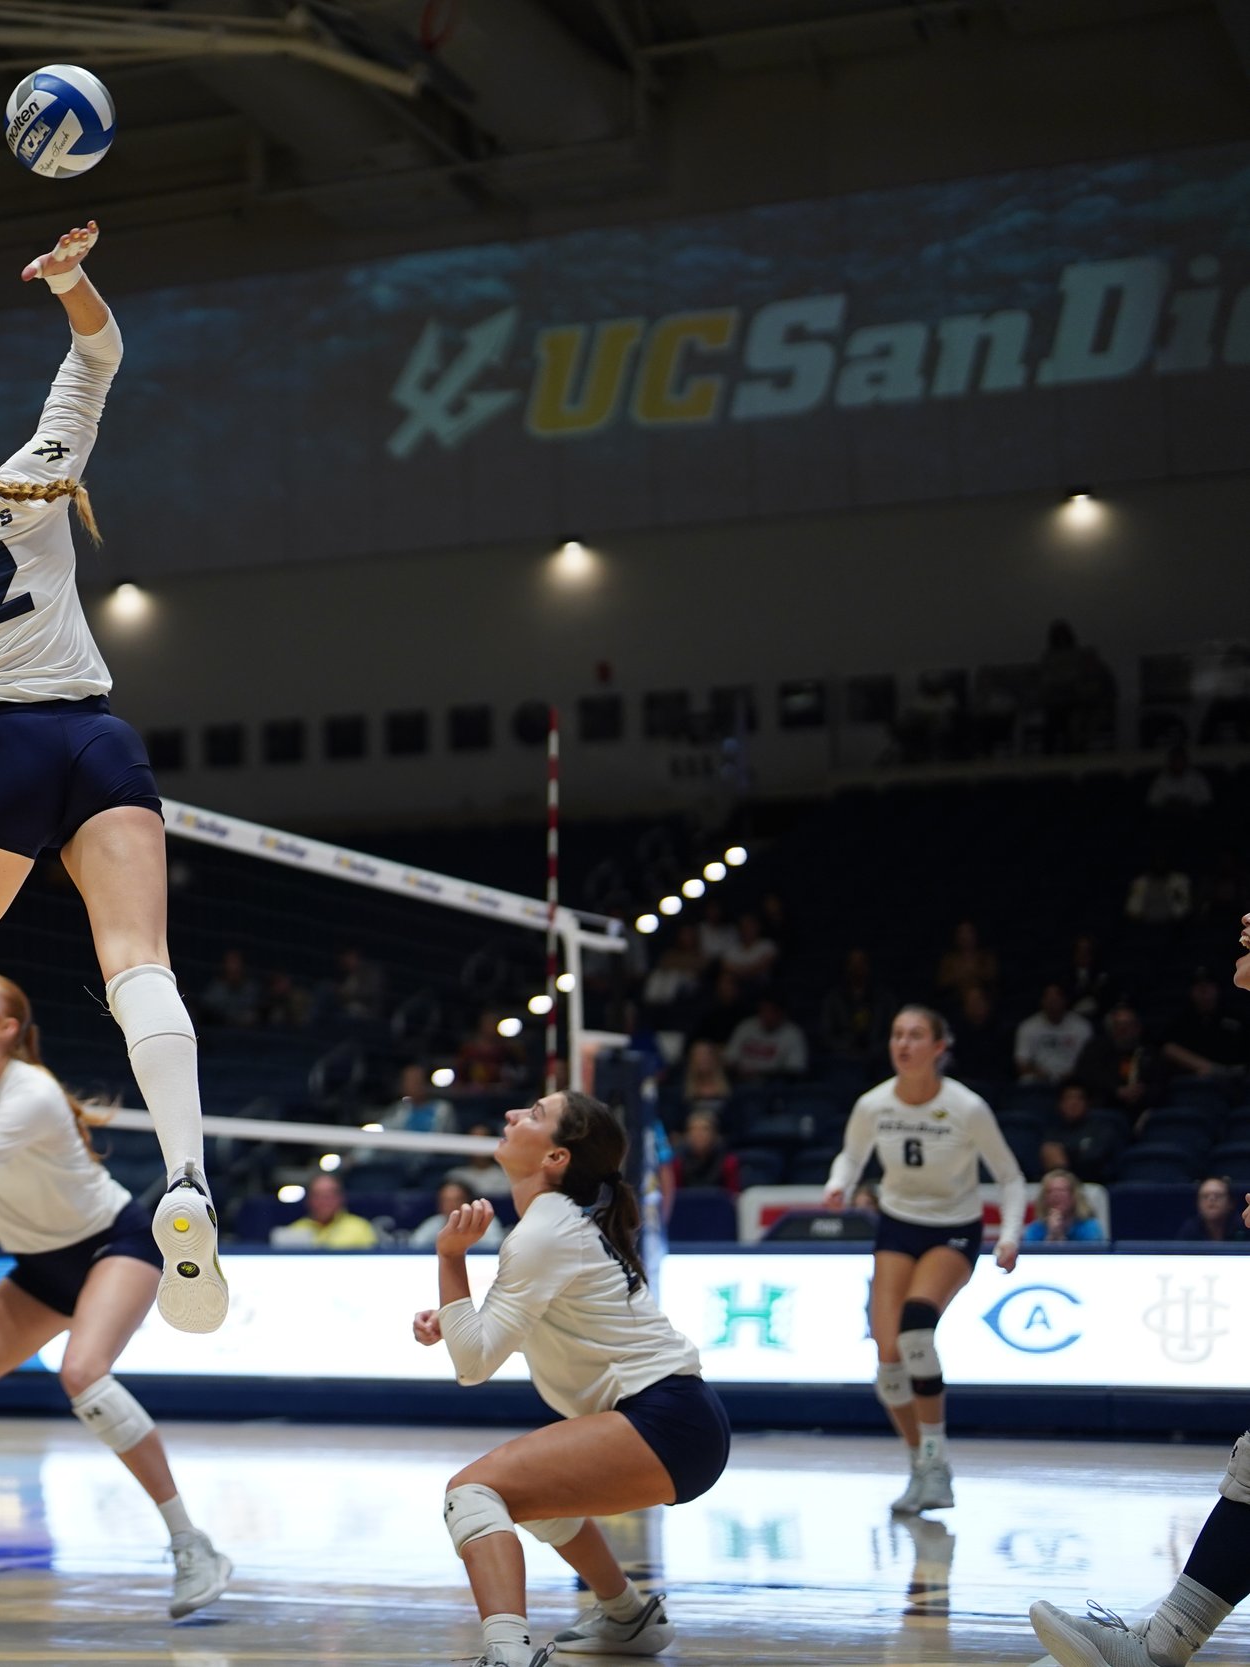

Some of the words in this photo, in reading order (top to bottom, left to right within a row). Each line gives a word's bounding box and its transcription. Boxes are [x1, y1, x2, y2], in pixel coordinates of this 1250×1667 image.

[9, 101, 40, 149] molten
[19, 119, 51, 161] NCAA
[904, 1138, 924, 1167] 6
